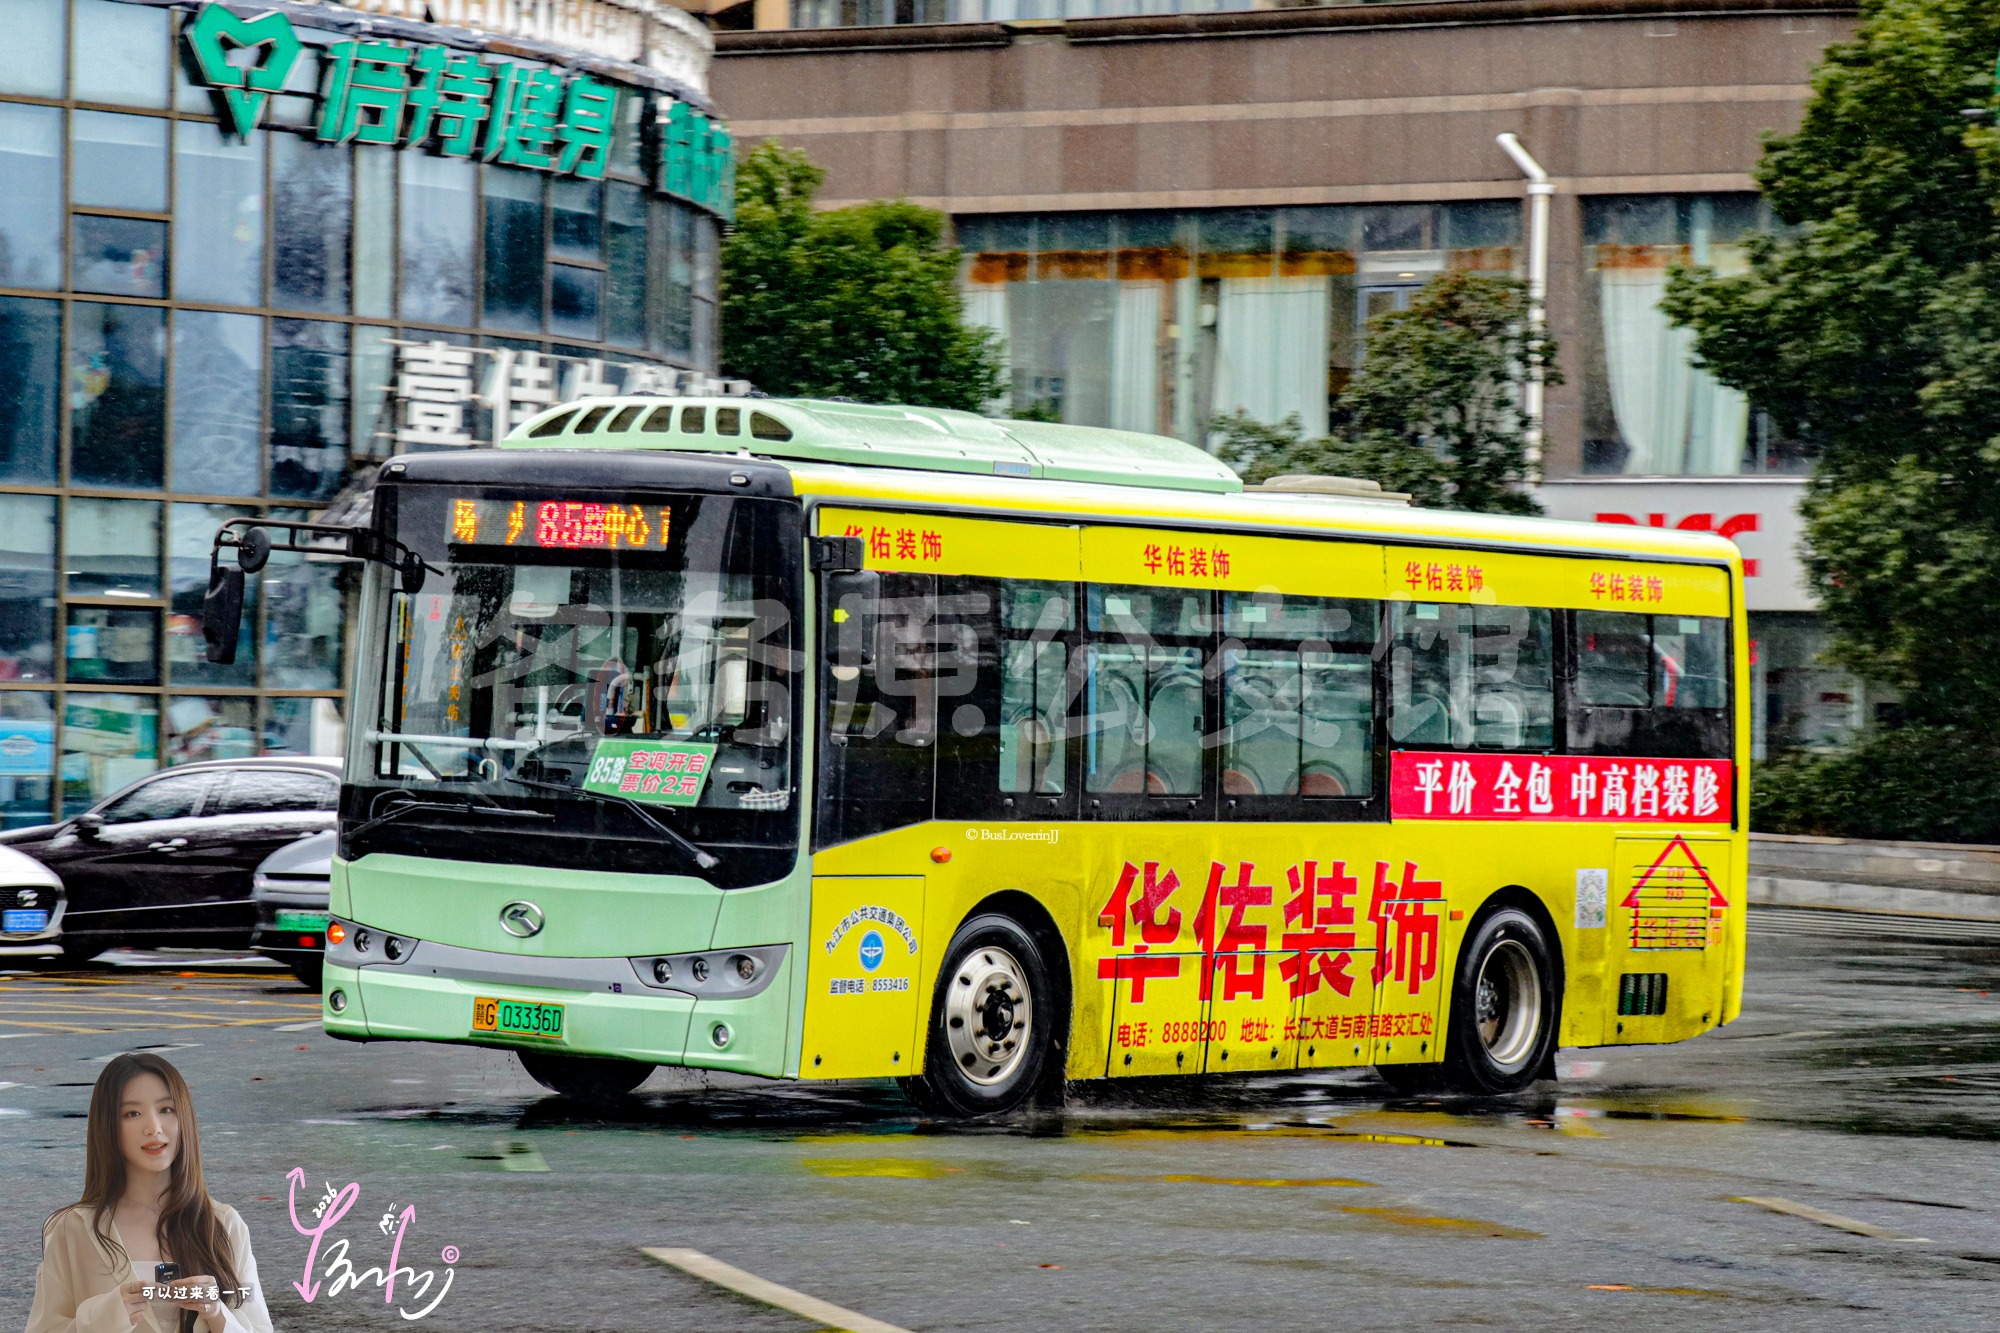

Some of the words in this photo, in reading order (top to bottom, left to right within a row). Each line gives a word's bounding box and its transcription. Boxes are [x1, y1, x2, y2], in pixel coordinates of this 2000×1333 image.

[317, 41, 617, 182] 倍特健身
[1143, 544, 1231, 579] 华佑装饰
[1405, 561, 1484, 593] 华佑装饰
[1590, 572, 1663, 603] 华佑装饰
[627, 750, 707, 773] 空调开启
[619, 773, 699, 795] 票价2元
[1414, 760, 1477, 814] 平价
[1493, 760, 1553, 814] 全包
[1571, 763, 1720, 817] 中高档装修
[825, 905, 918, 955] 九江市公共交通集团公司
[1097, 860, 1442, 1004] 华佑装饰
